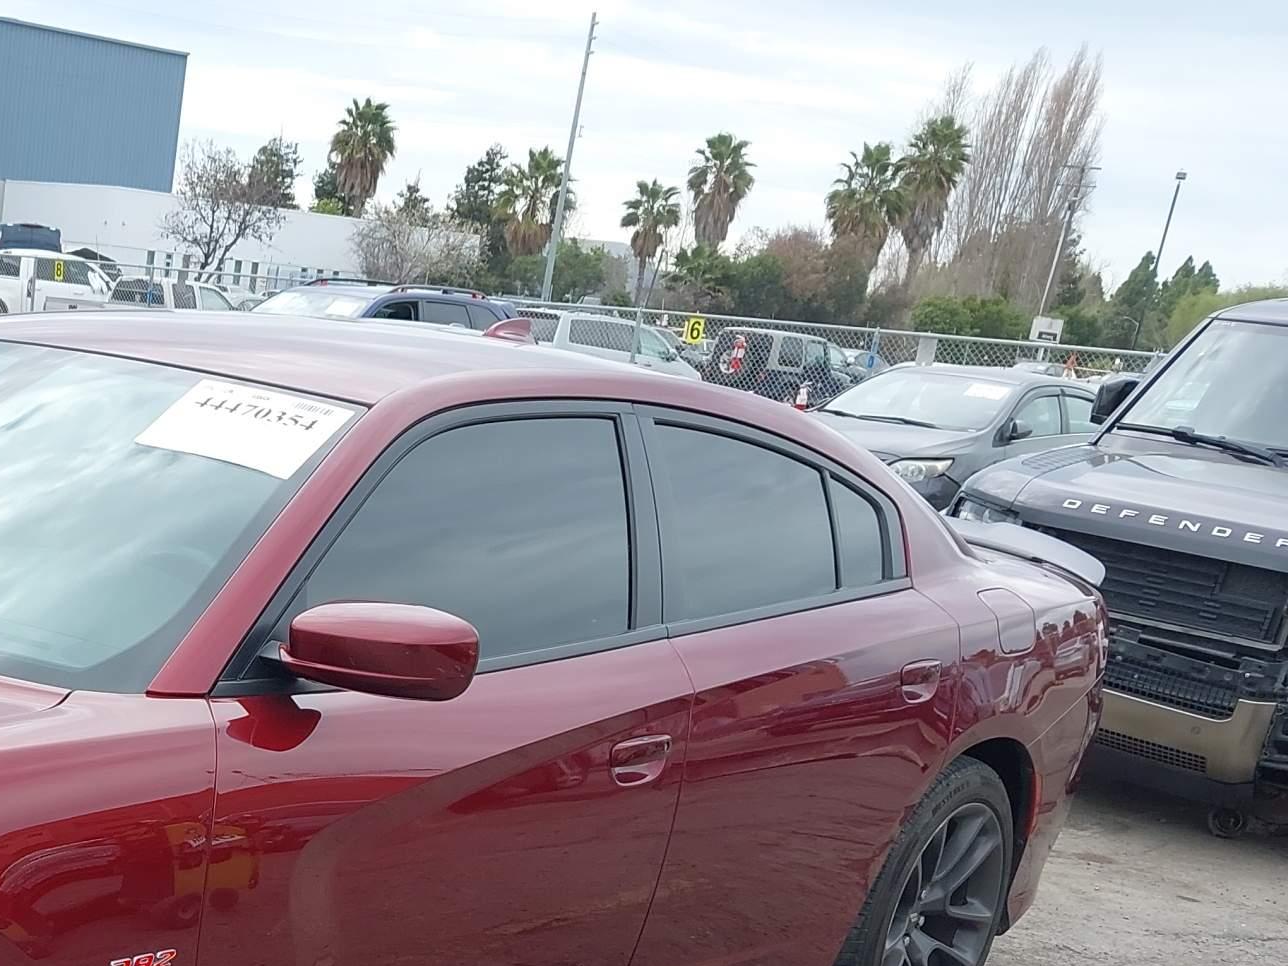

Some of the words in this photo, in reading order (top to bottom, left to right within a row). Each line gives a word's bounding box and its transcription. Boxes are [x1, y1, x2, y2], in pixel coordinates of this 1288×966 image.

[56, 262, 62, 277] 8
[690, 321, 702, 340] 6
[195, 397, 319, 431] 44470354
